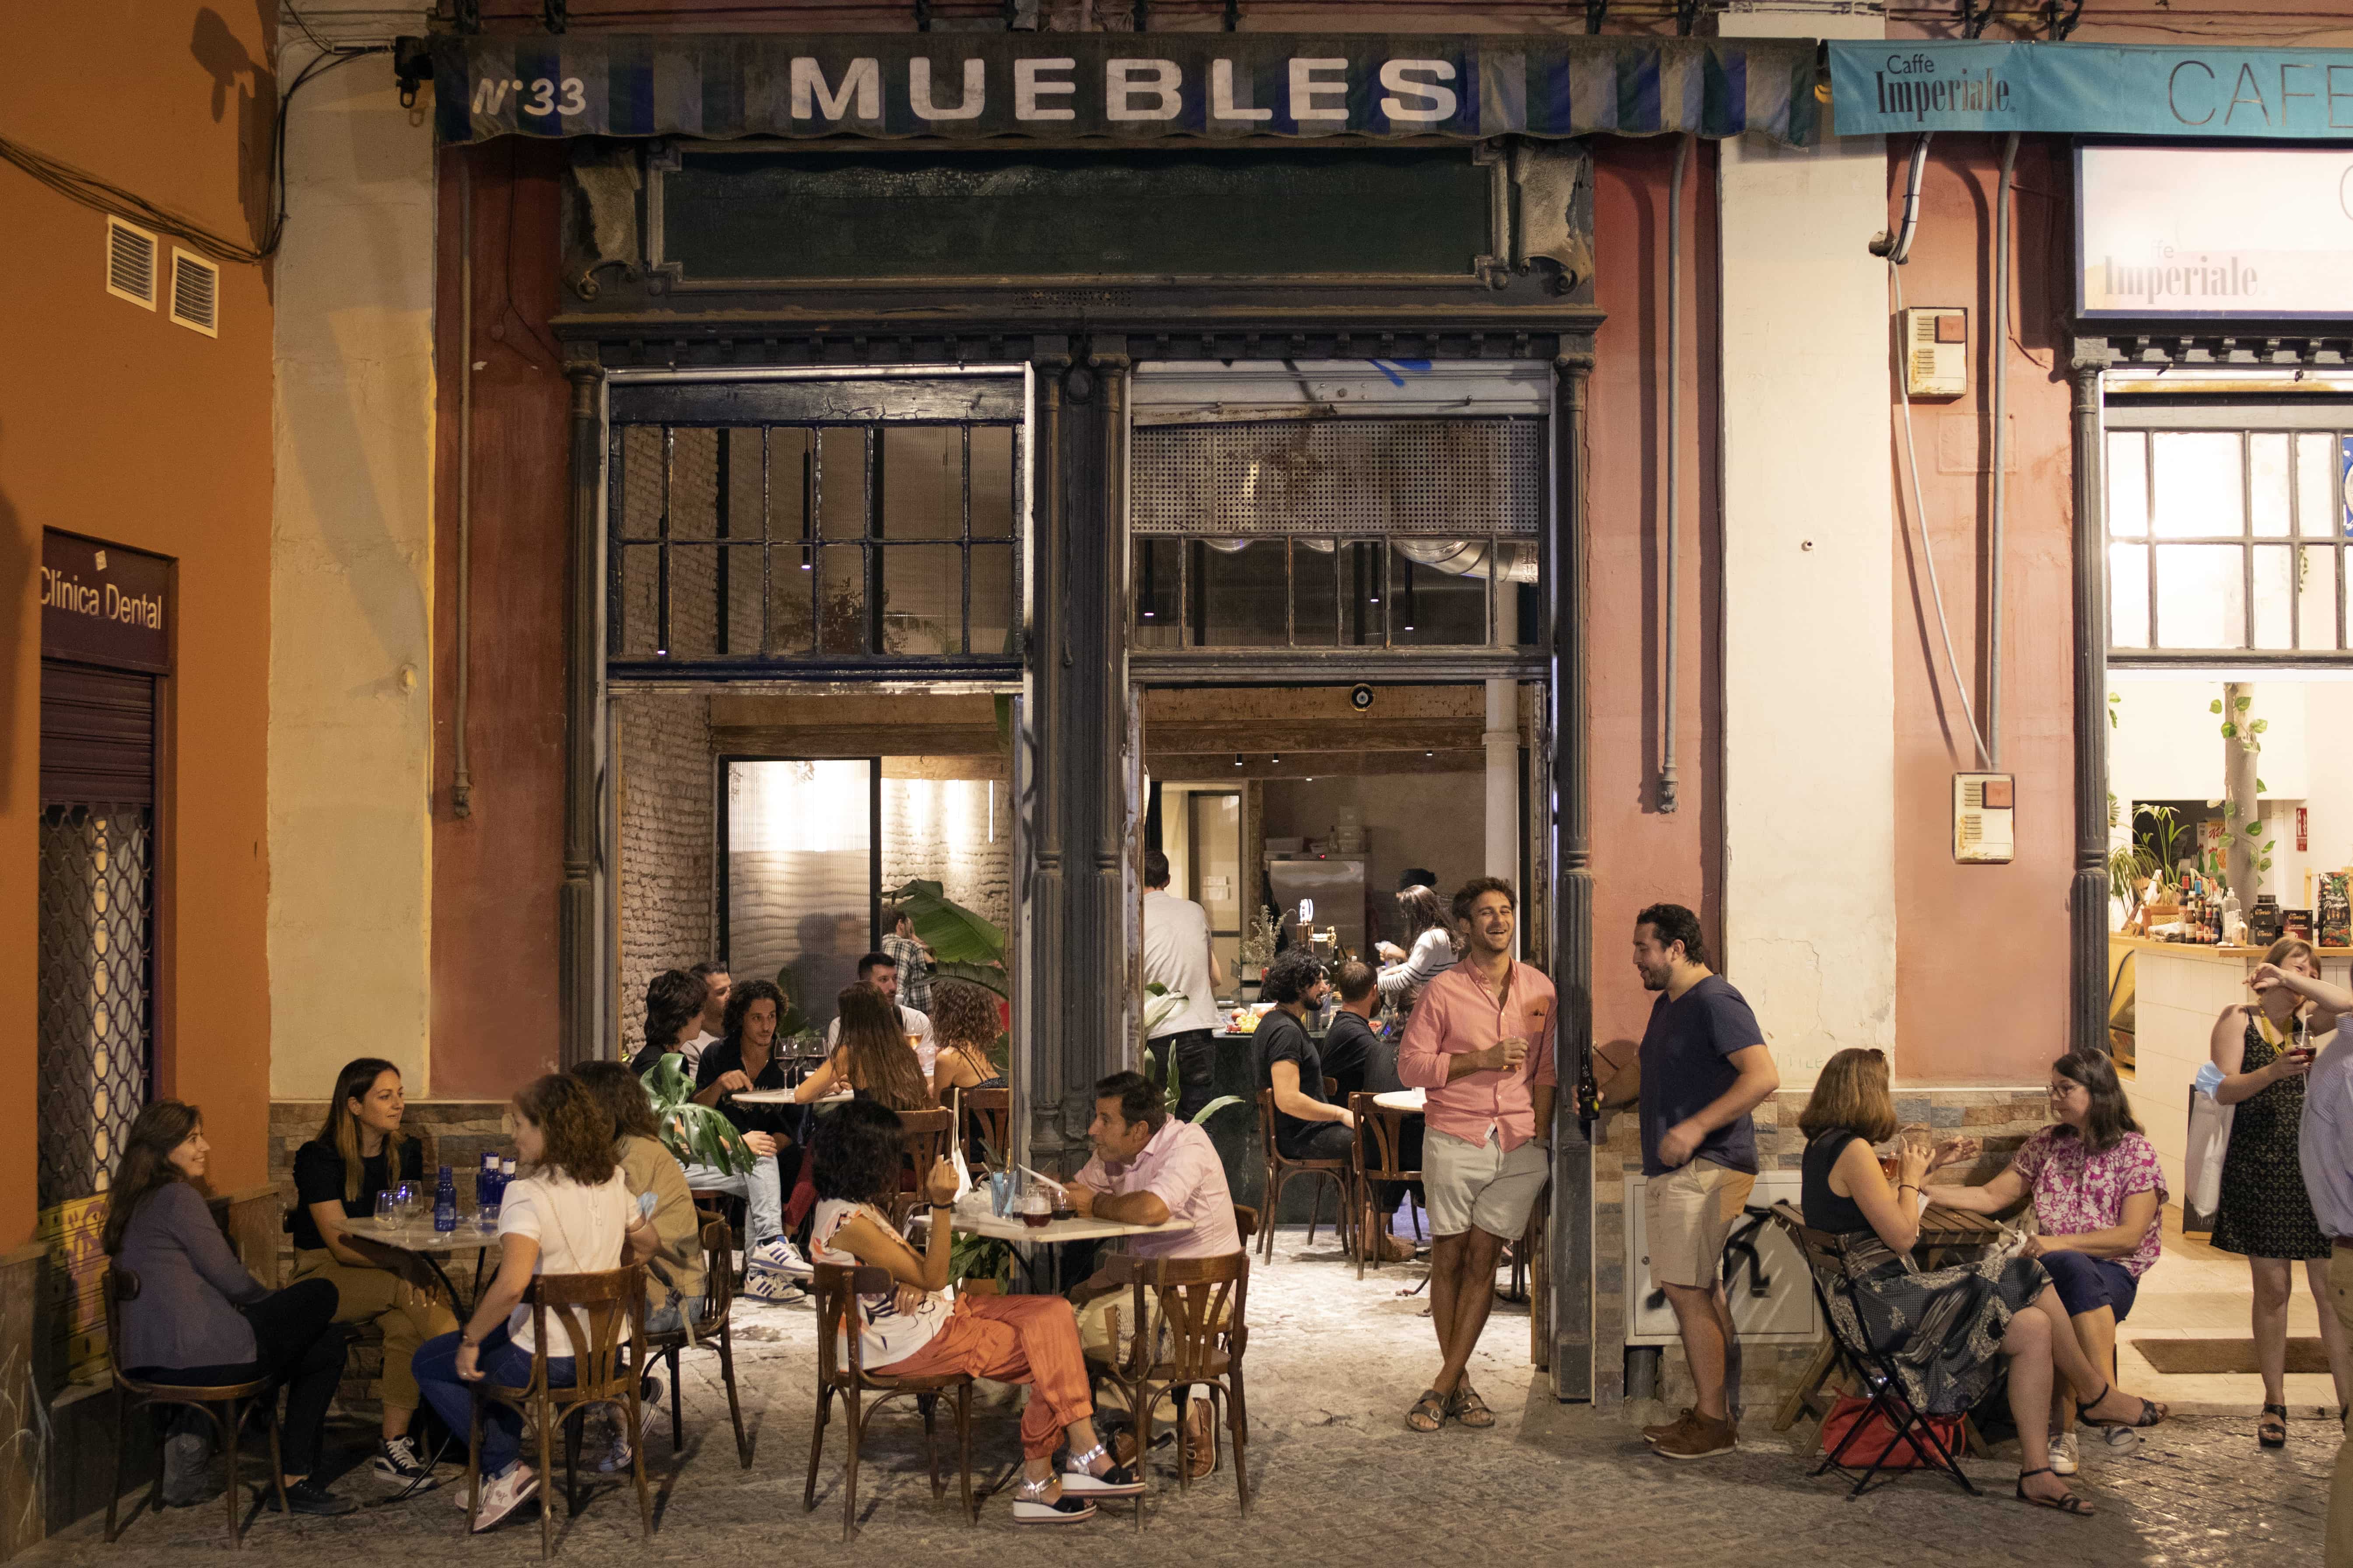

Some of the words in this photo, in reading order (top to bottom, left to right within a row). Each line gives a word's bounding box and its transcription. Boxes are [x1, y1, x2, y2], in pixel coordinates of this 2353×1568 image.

[791, 57, 1457, 121] MUEBLES
[1875, 67, 2010, 122] Imperiale
[2104, 255, 2258, 304] Imperiale
[105, 583, 161, 630] Dental
